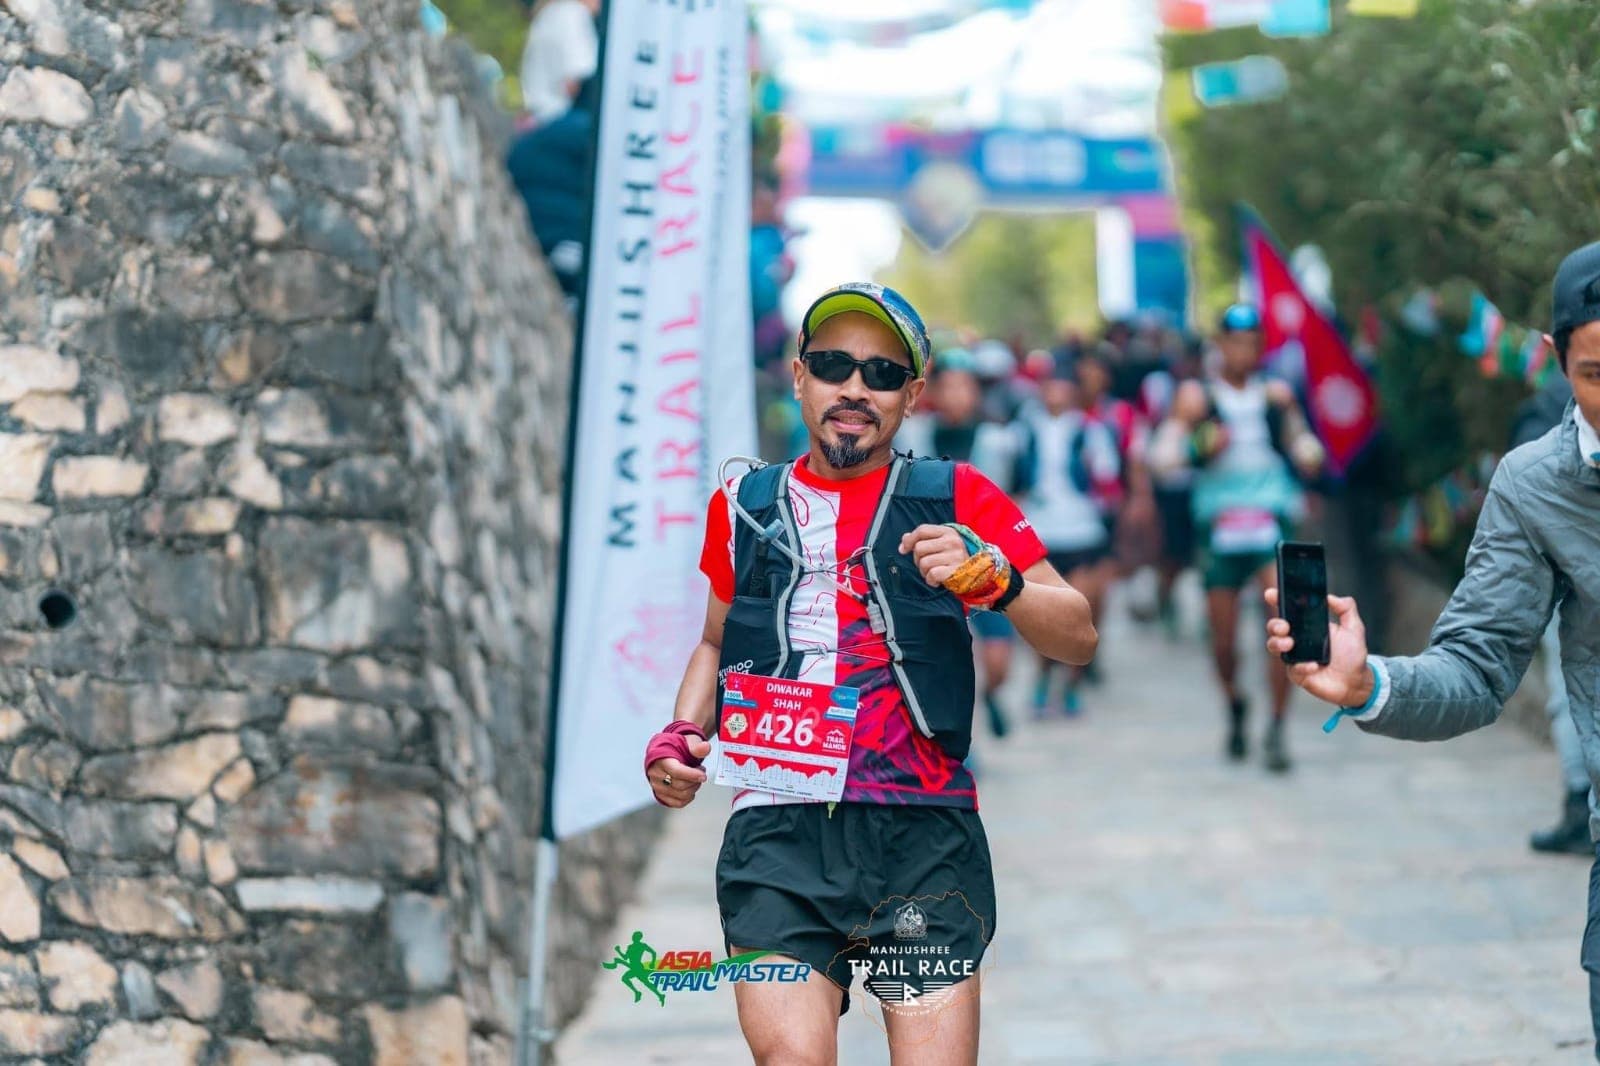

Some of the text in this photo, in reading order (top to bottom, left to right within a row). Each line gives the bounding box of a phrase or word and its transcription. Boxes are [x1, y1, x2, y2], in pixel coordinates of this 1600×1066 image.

[657, 45, 706, 259] RACE
[604, 38, 661, 549] MANJUSHREE
[654, 291, 703, 543] TRAIL
[755, 712, 814, 747] 426
[766, 682, 813, 698] DIWAKAR
[773, 698, 802, 711] SHAH
